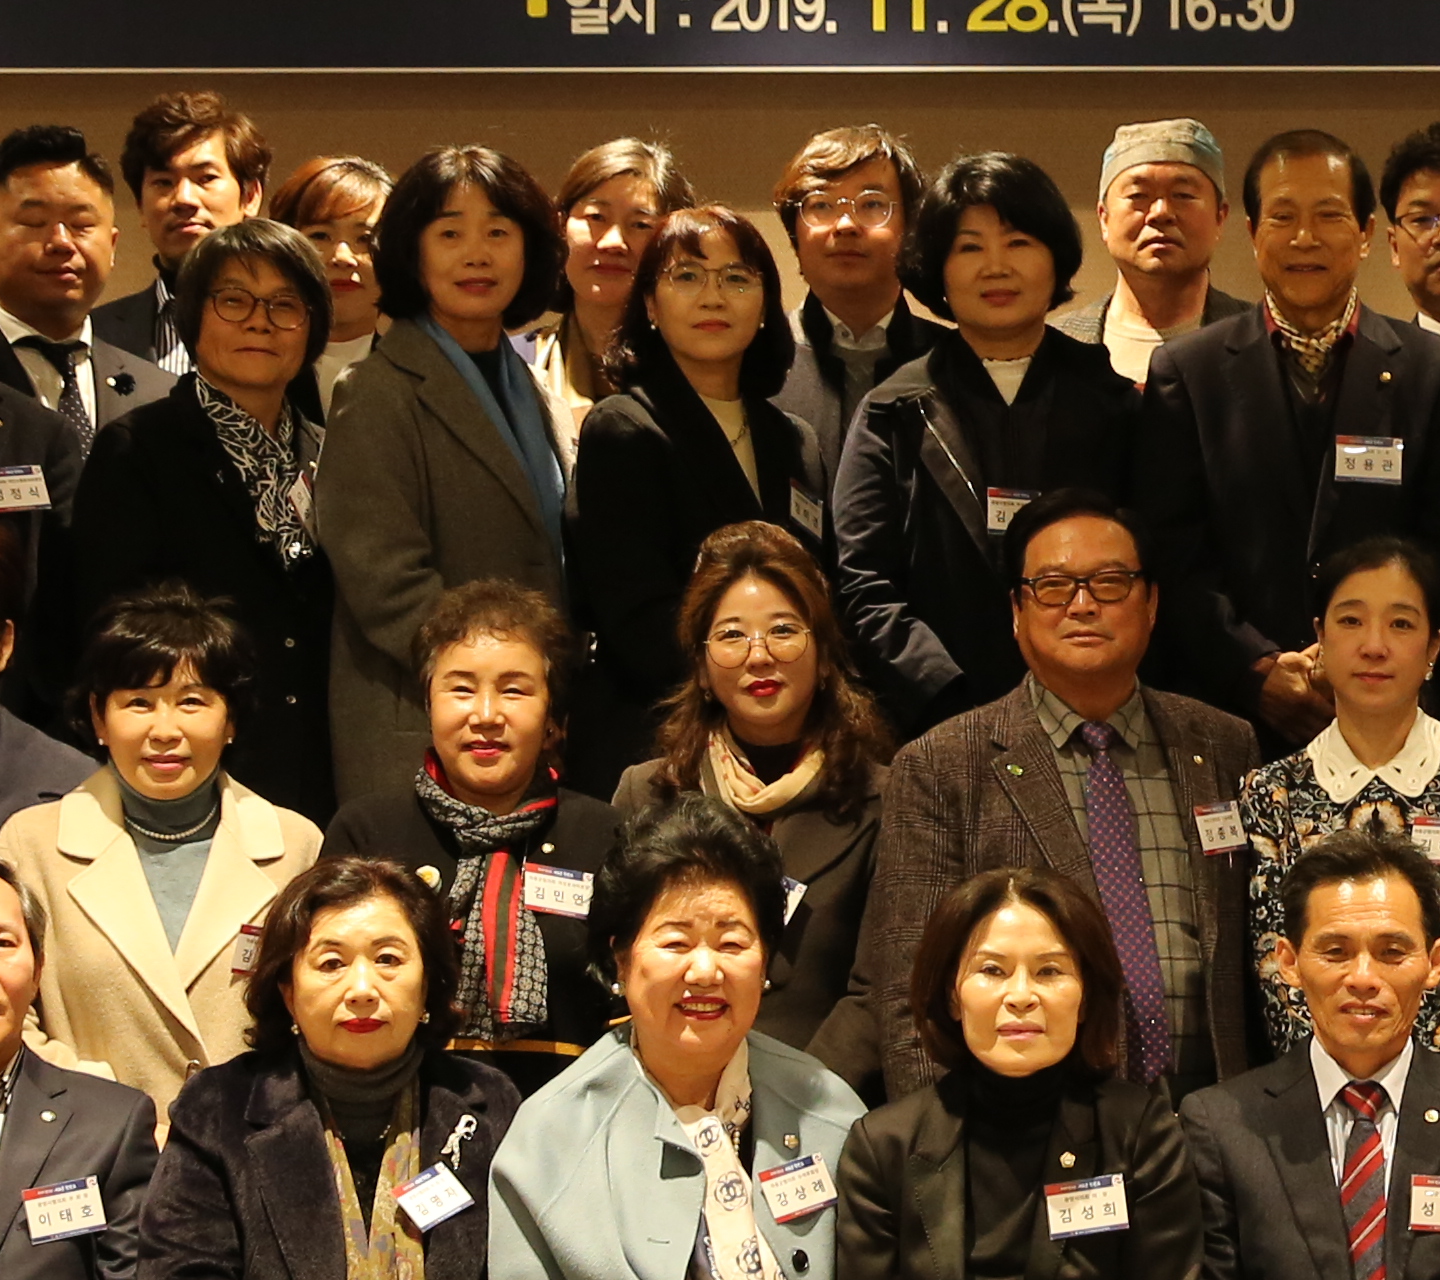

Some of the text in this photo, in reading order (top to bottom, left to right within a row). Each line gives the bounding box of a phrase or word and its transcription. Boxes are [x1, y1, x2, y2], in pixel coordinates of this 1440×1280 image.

[534, 885, 585, 907] 김민연
[775, 1178, 827, 1208] 강상례
[38, 1204, 95, 1227] 이태호
[1059, 1201, 1117, 1224] 김성희
